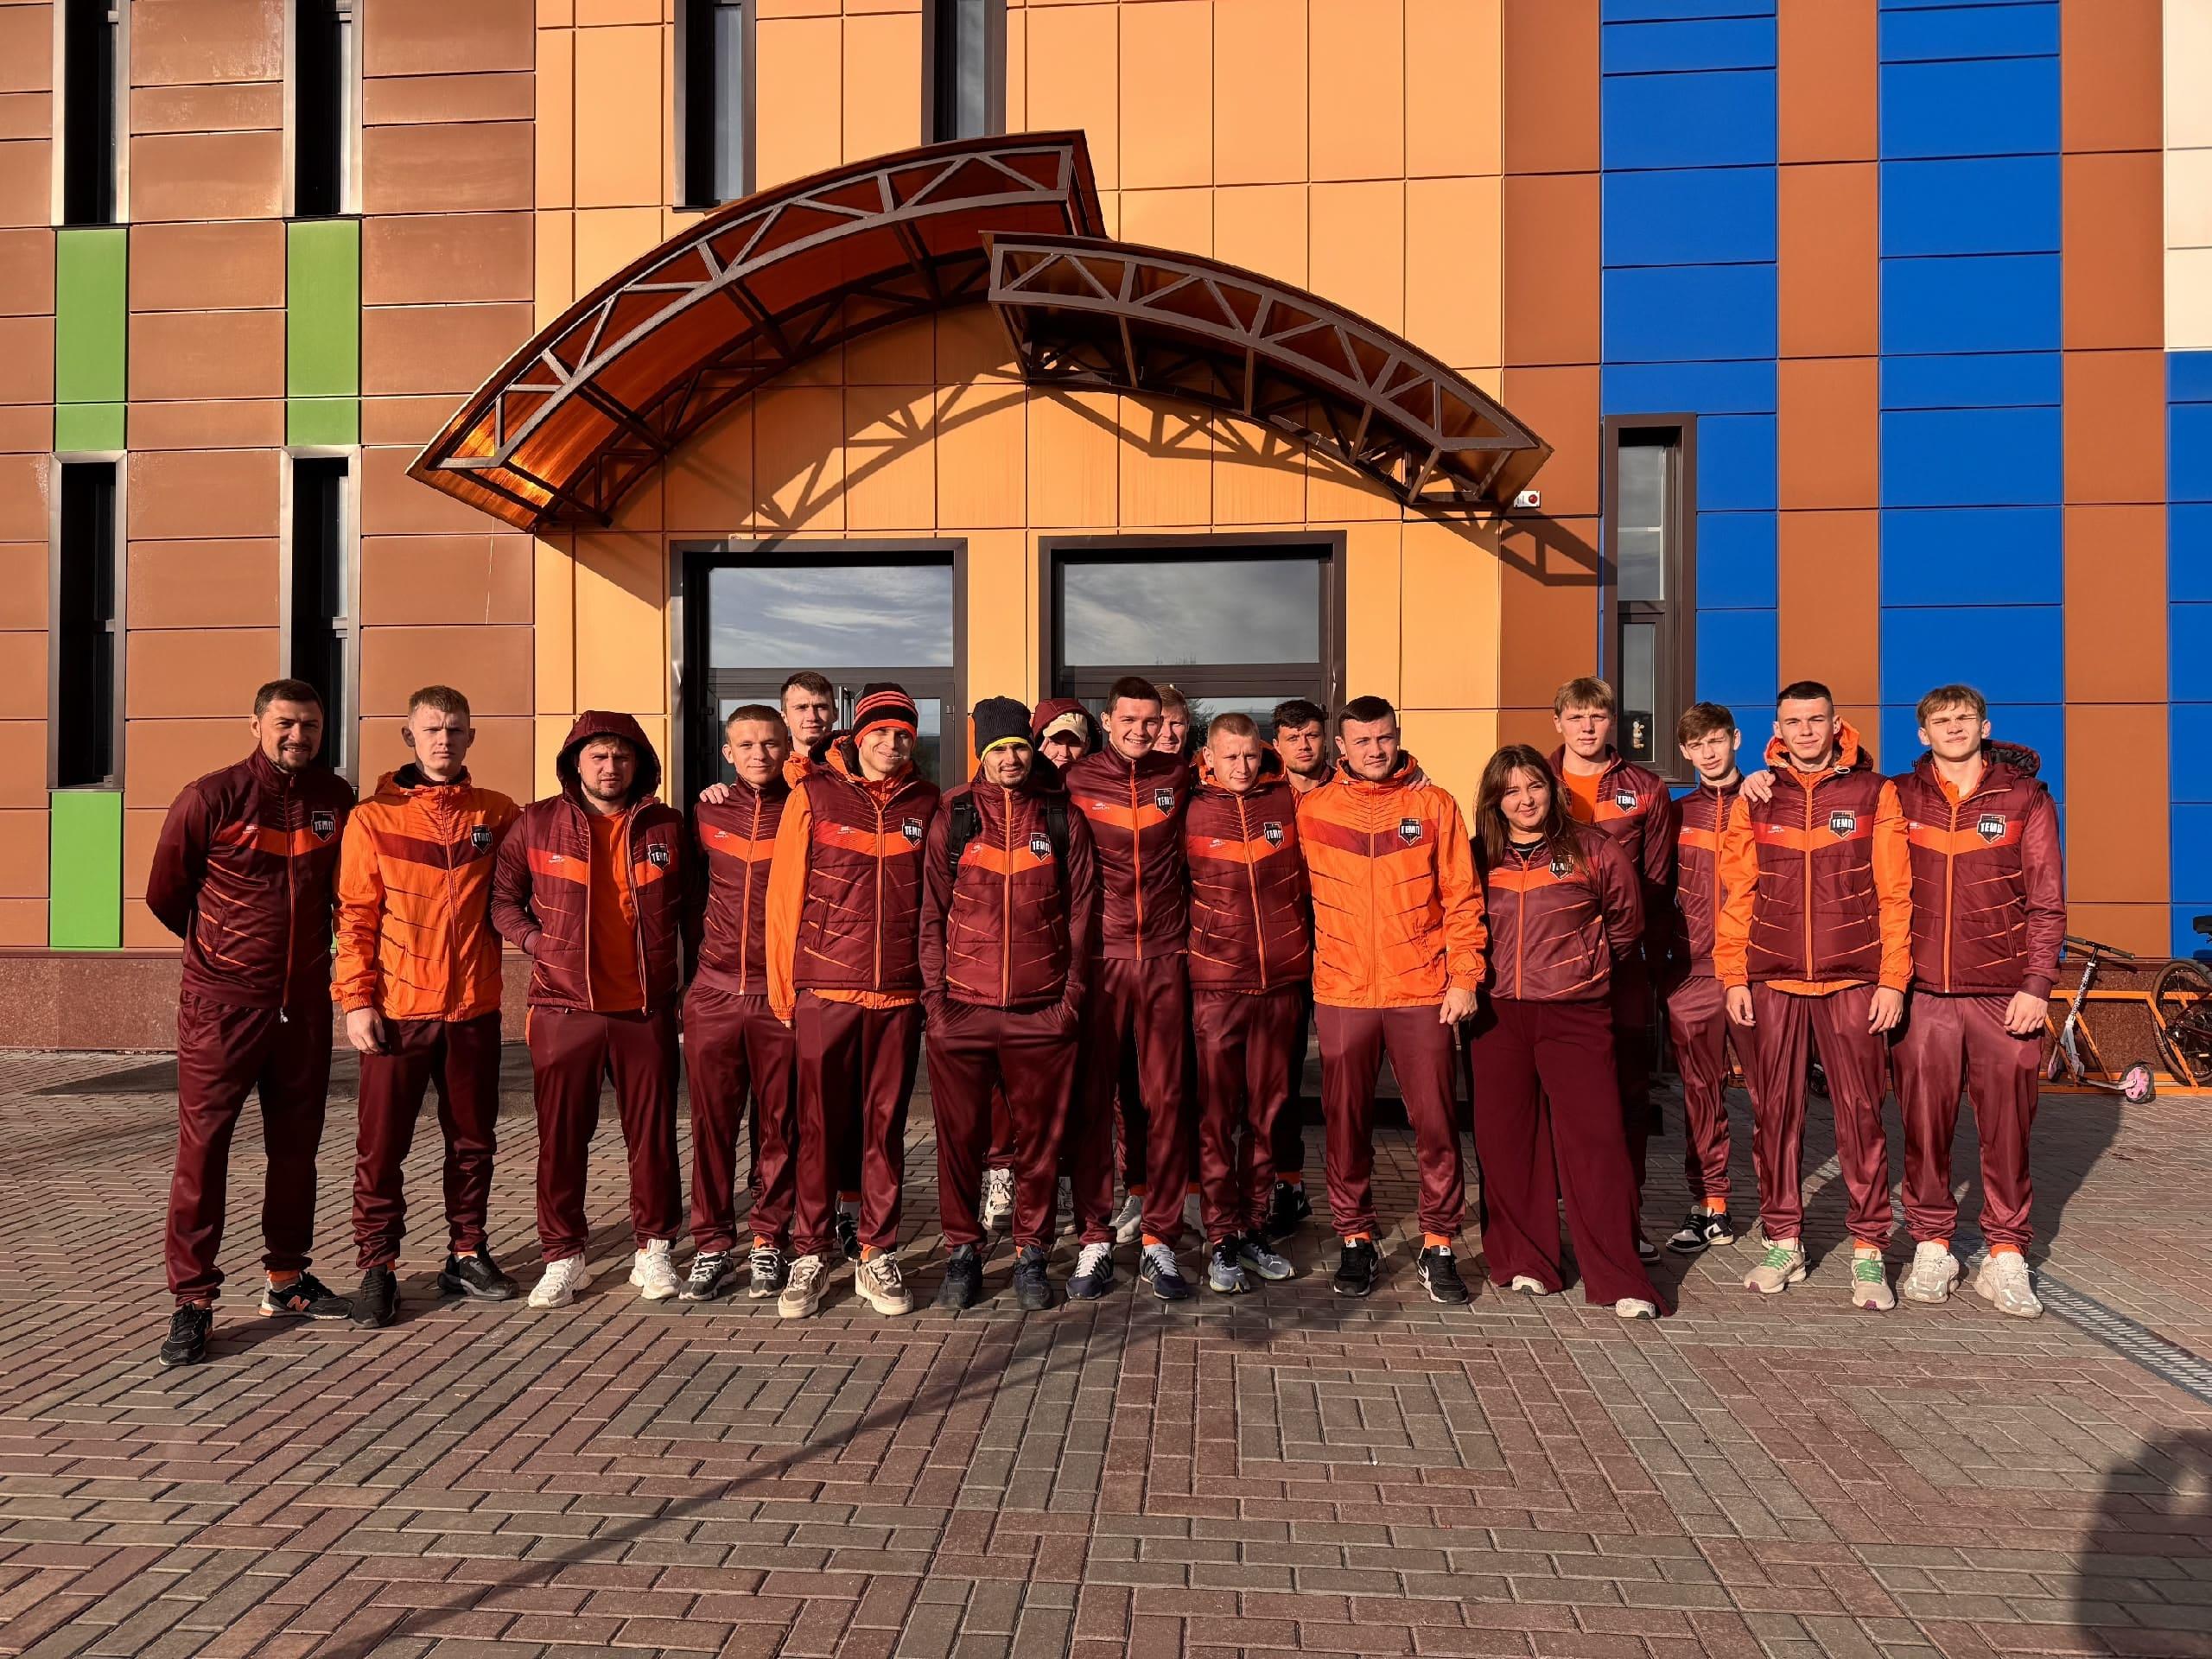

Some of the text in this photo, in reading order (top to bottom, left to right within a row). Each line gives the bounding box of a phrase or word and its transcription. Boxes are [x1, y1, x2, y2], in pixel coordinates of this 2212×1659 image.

[1833, 819, 1853, 829] ТЕМП
[1980, 823, 2003, 833] ТЕМП
[287, 1295, 310, 1313] N
